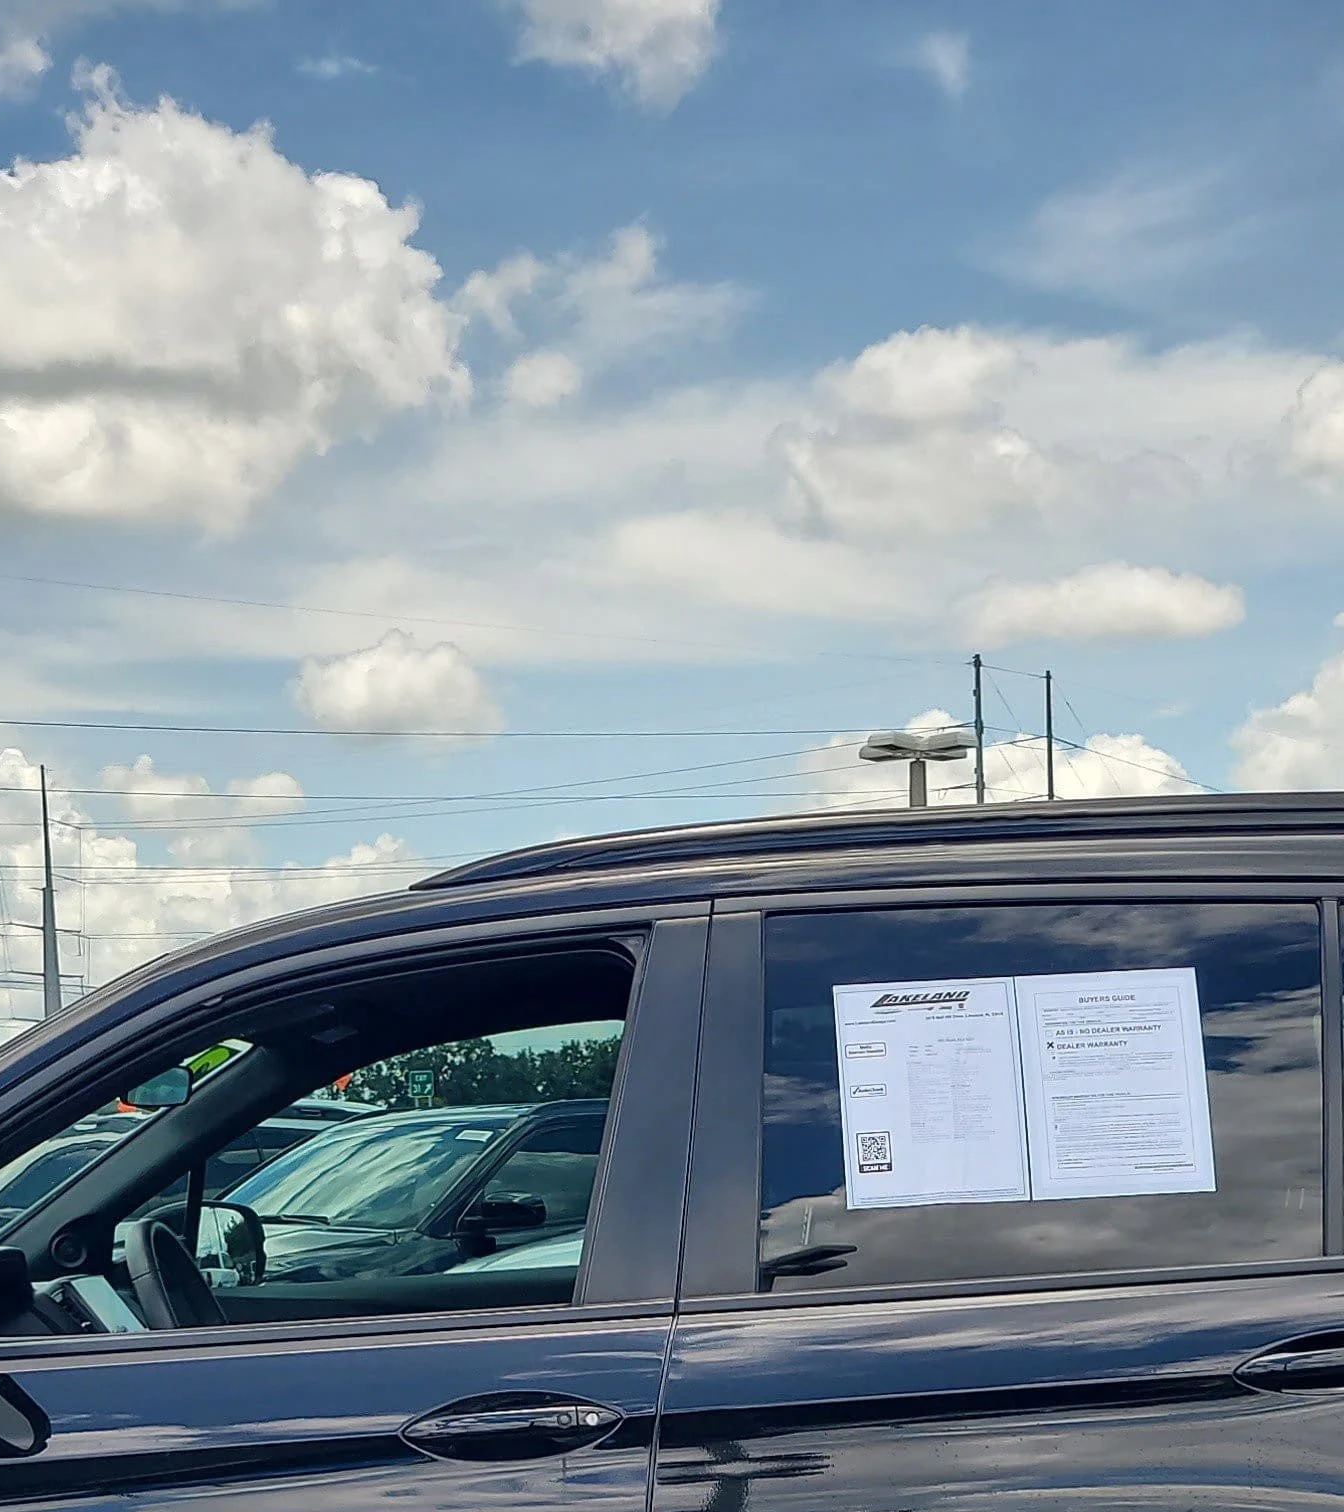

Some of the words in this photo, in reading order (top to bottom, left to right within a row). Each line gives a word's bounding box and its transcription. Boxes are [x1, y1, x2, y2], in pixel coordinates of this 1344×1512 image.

[870, 990, 971, 1008] LAKELAND
[1078, 995, 1110, 1004] BUYERS
[1122, 1024, 1162, 1032] WARRANTY
[1056, 1042, 1086, 1050] DEALER
[1087, 1040, 1128, 1048] WARRANTY
